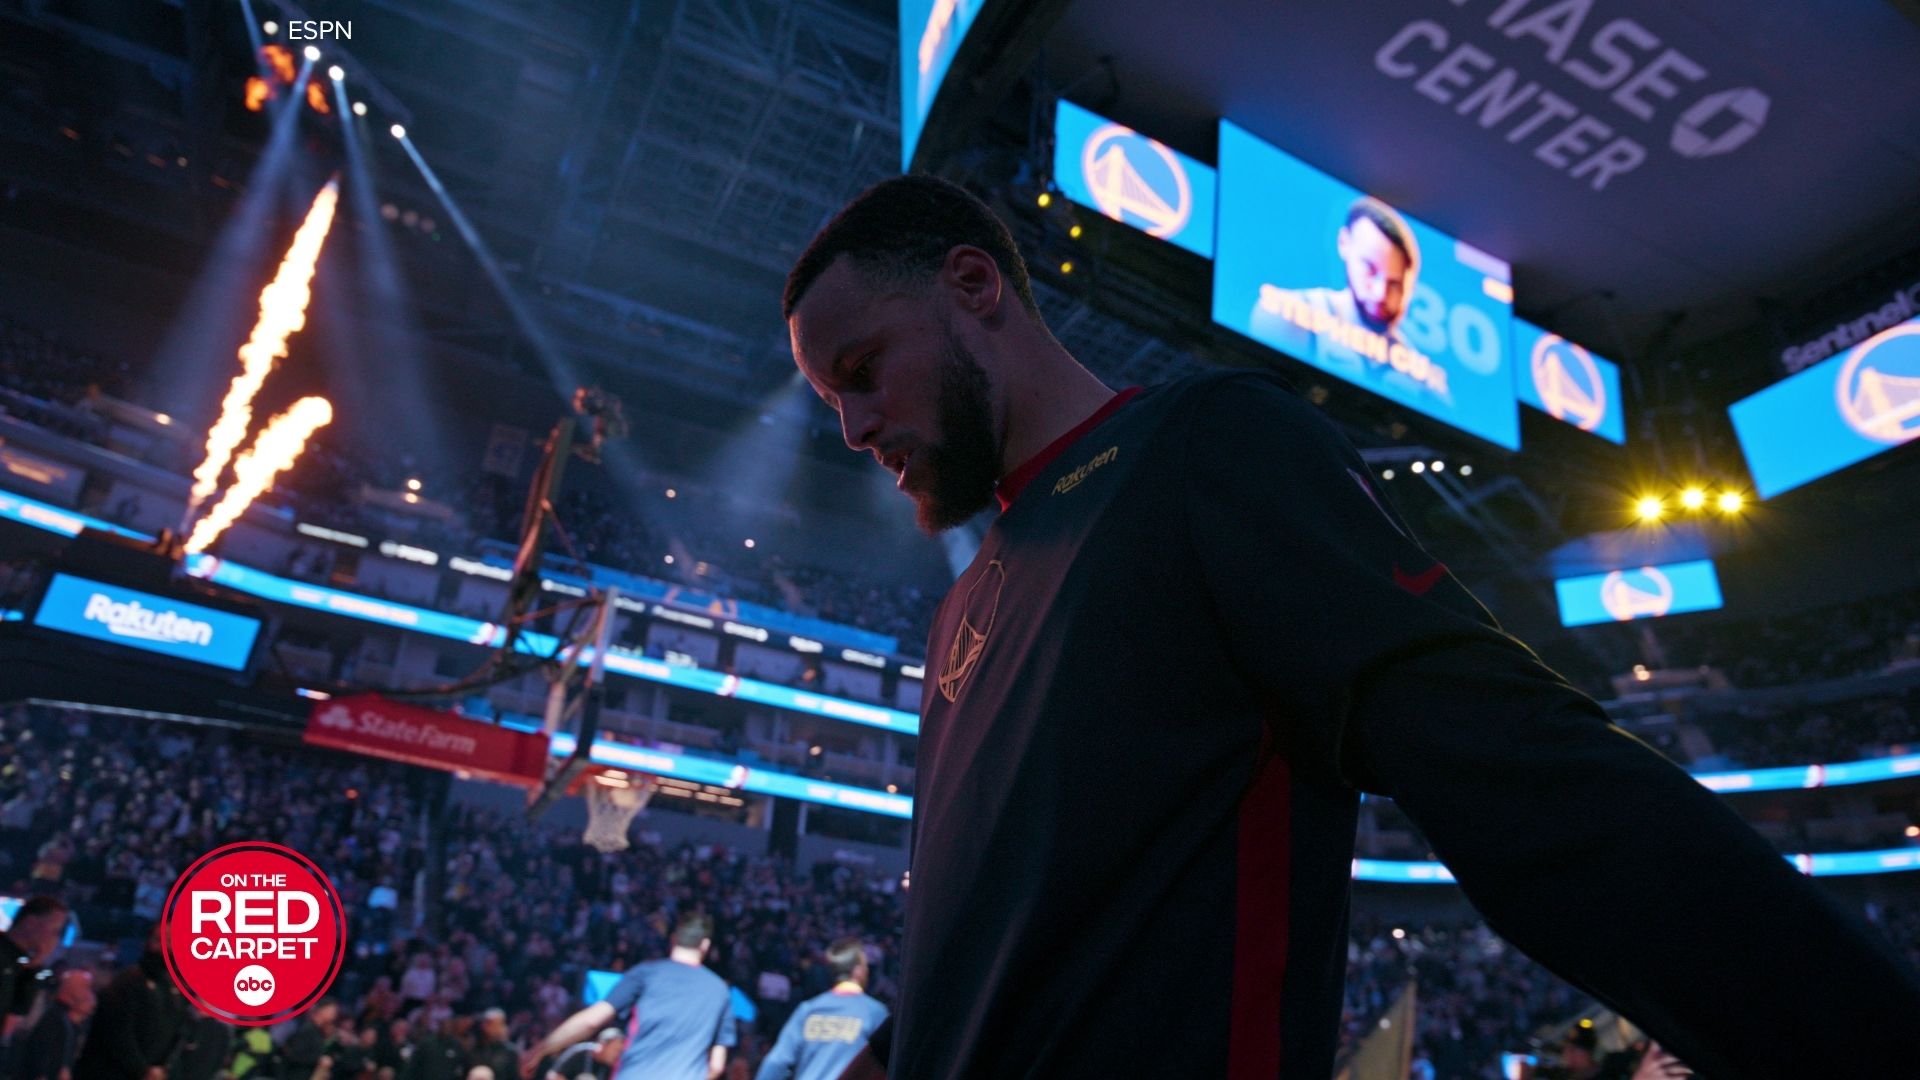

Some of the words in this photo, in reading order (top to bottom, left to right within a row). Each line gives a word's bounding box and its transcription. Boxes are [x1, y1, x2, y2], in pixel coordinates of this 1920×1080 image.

[1373, 18, 1648, 191] CENTER
[1399, 281, 1500, 376] 30
[1051, 446, 1118, 496] Rakuten
[83, 593, 213, 646] Rakuten
[803, 1013, 864, 1045] GSW
